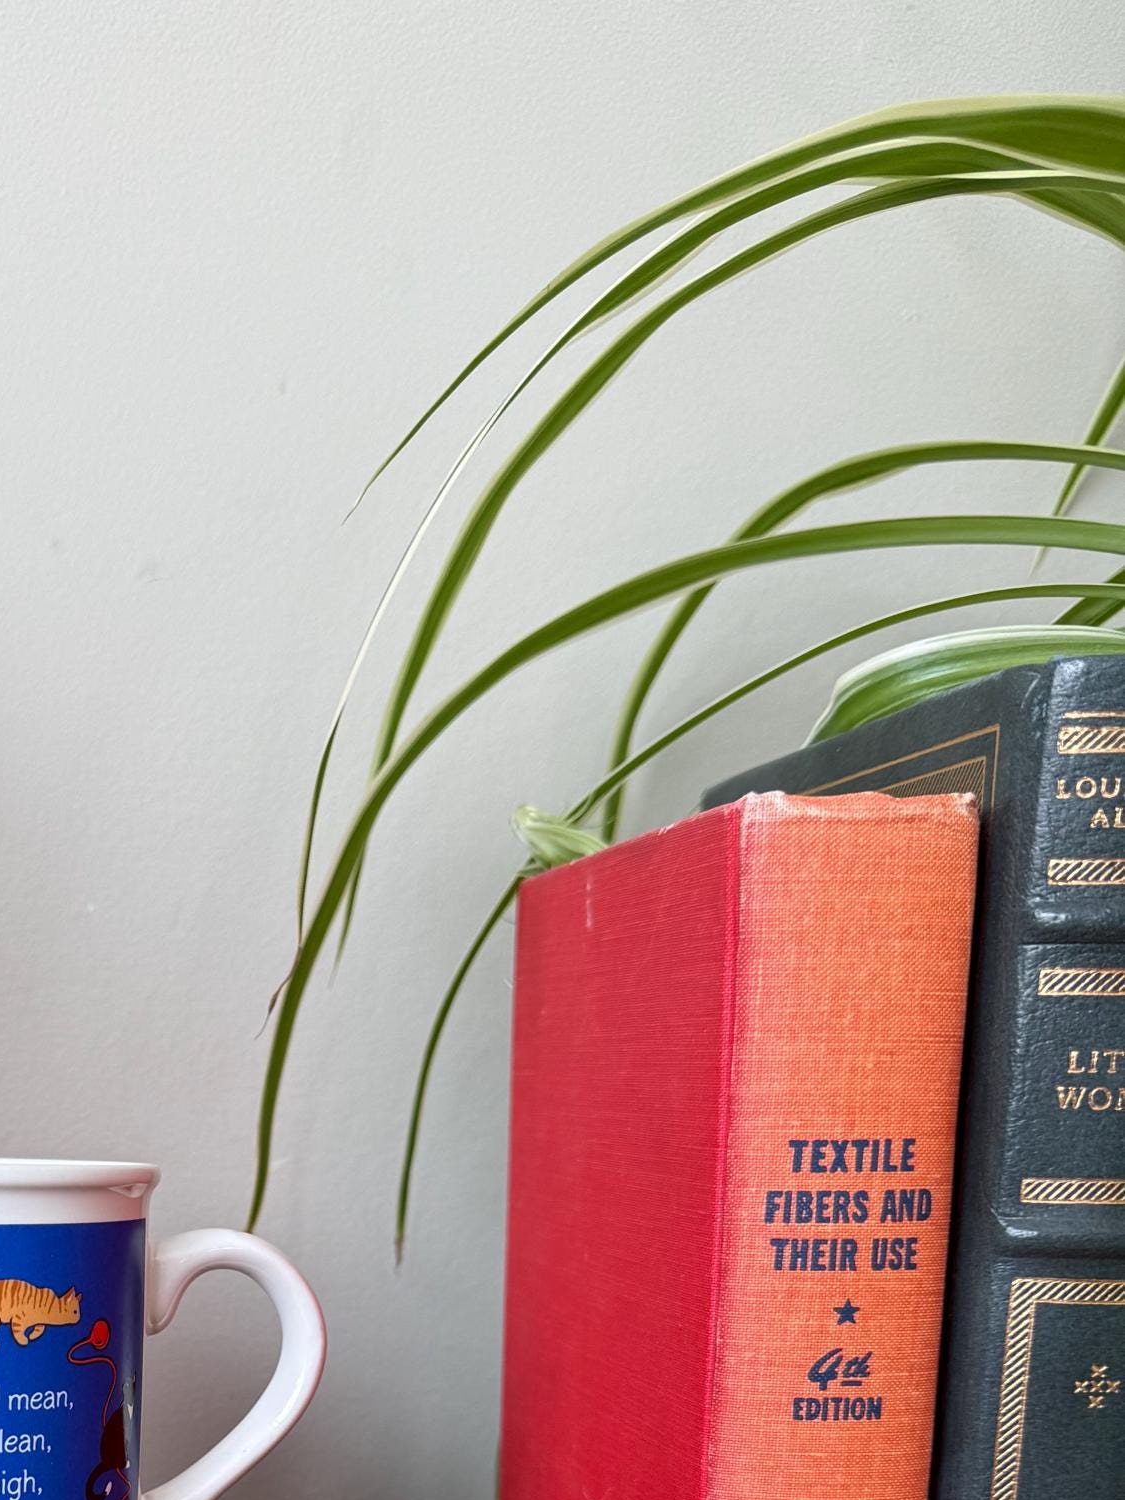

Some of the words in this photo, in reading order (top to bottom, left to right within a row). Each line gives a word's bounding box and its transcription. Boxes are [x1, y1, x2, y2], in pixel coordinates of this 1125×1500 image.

[1056, 776, 1121, 799] LOU
[1067, 1051, 1125, 1073] LIT
[788, 1137, 916, 1174] TEXTILE
[764, 1190, 870, 1224] FIBERS
[879, 1188, 933, 1224] AND
[769, 1238, 858, 1272] THEIR
[870, 1236, 918, 1272] USE
[807, 1348, 873, 1392] 4th
[8, 1390, 73, 1411] mean,
[792, 1396, 883, 1422] EDITION
[0, 1429, 51, 1453] lean,
